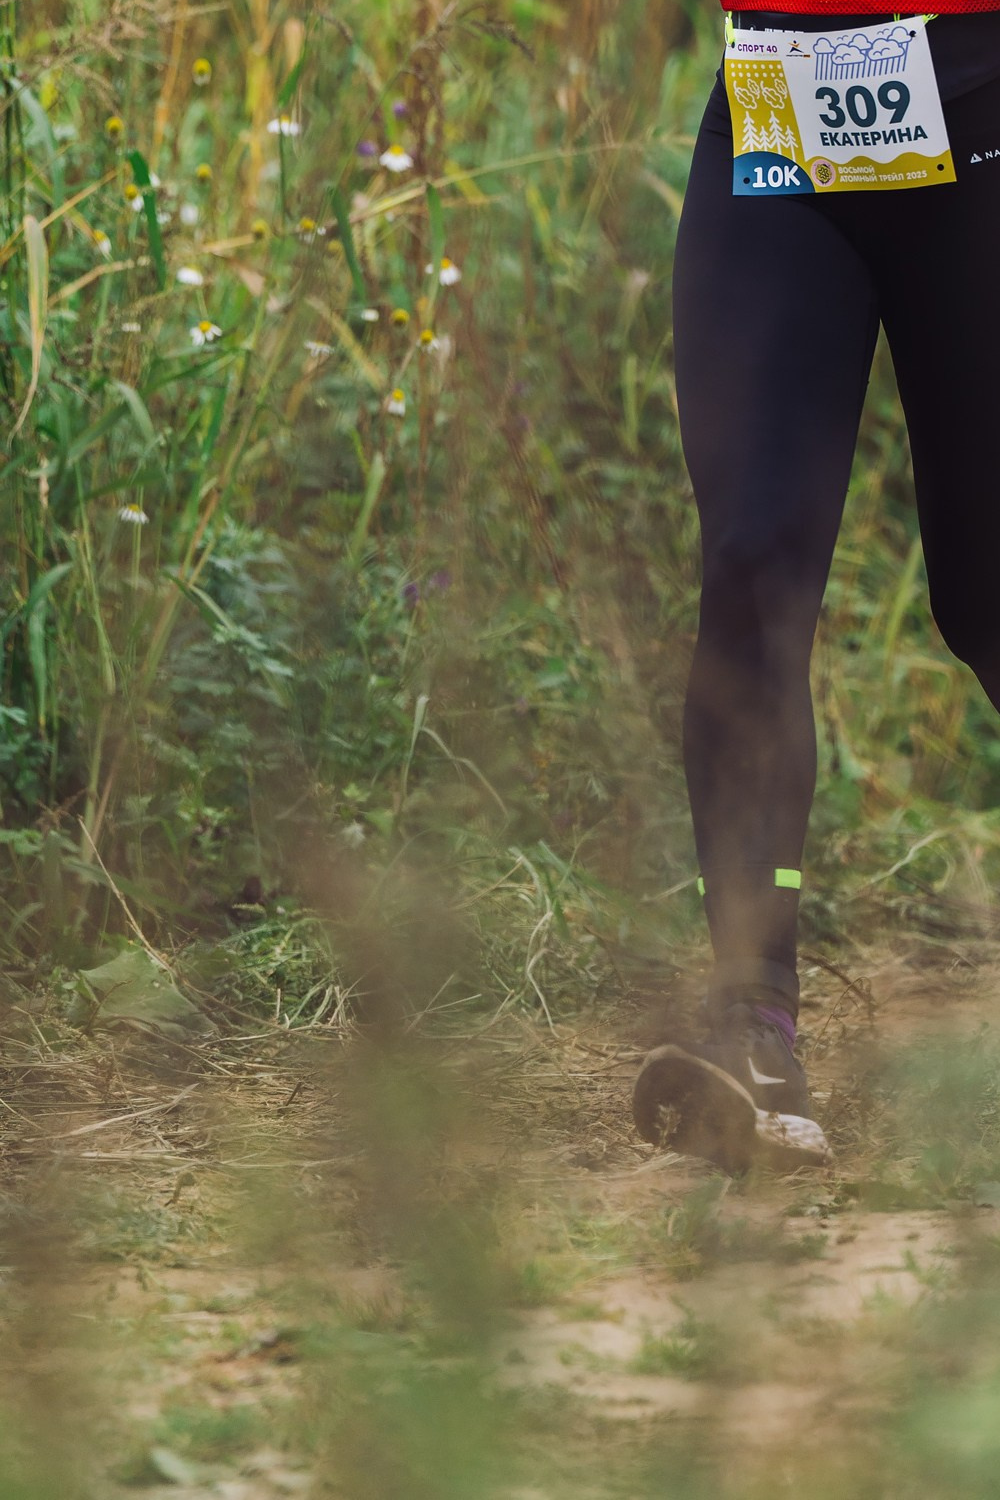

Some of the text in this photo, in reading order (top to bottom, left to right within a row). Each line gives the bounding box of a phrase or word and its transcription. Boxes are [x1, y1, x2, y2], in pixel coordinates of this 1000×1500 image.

[737, 43, 778, 53] СПОРТ 40
[815, 81, 911, 128] 309
[819, 125, 928, 147] ЕКАТЕРИНА
[838, 165, 875, 174] ВОСЬМОЙ
[839, 170, 927, 183] АТОМНЫЙ ТРЕЙЛ 2025
